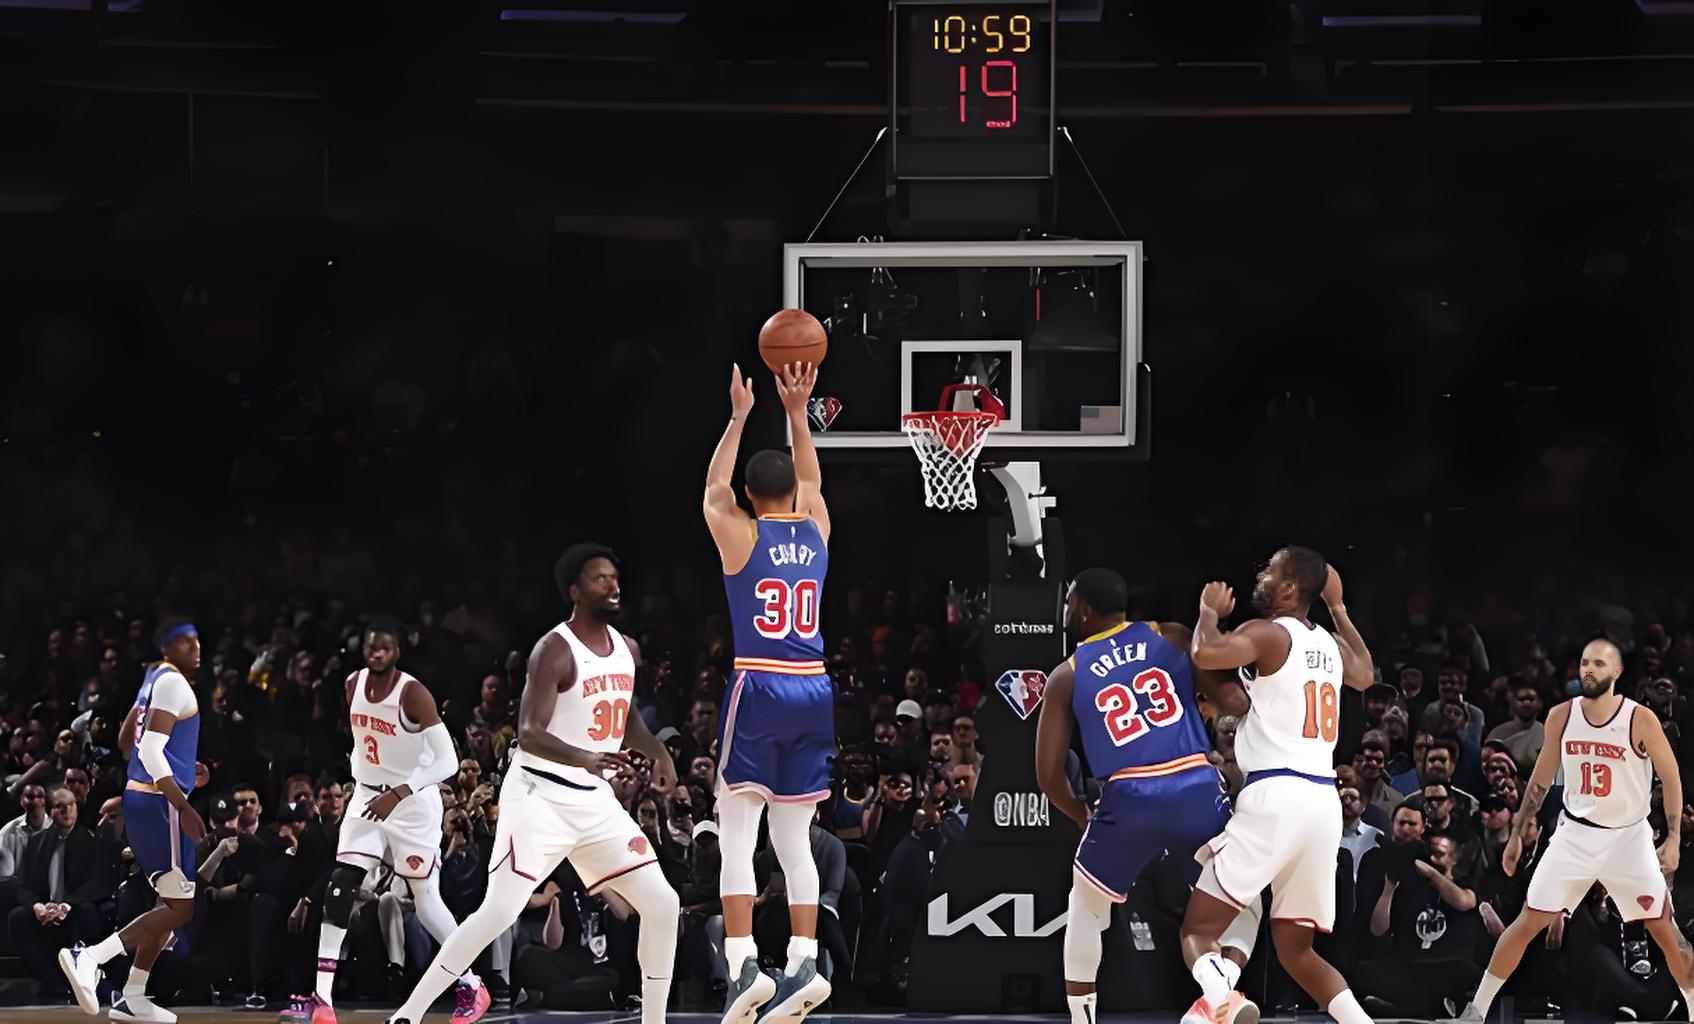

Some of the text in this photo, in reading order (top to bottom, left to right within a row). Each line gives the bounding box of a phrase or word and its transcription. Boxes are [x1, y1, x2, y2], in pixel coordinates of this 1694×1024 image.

[933, 15, 1031, 53] 10:59
[959, 60, 1017, 128] 19
[753, 578, 820, 640] 30
[1090, 641, 1147, 677] GREEN
[587, 698, 629, 741] 30
[1095, 667, 1184, 747] 23
[1302, 680, 1337, 743] 18
[364, 735, 380, 765] 3
[1580, 762, 1612, 797] 13
[994, 792, 1050, 826] @NBA
